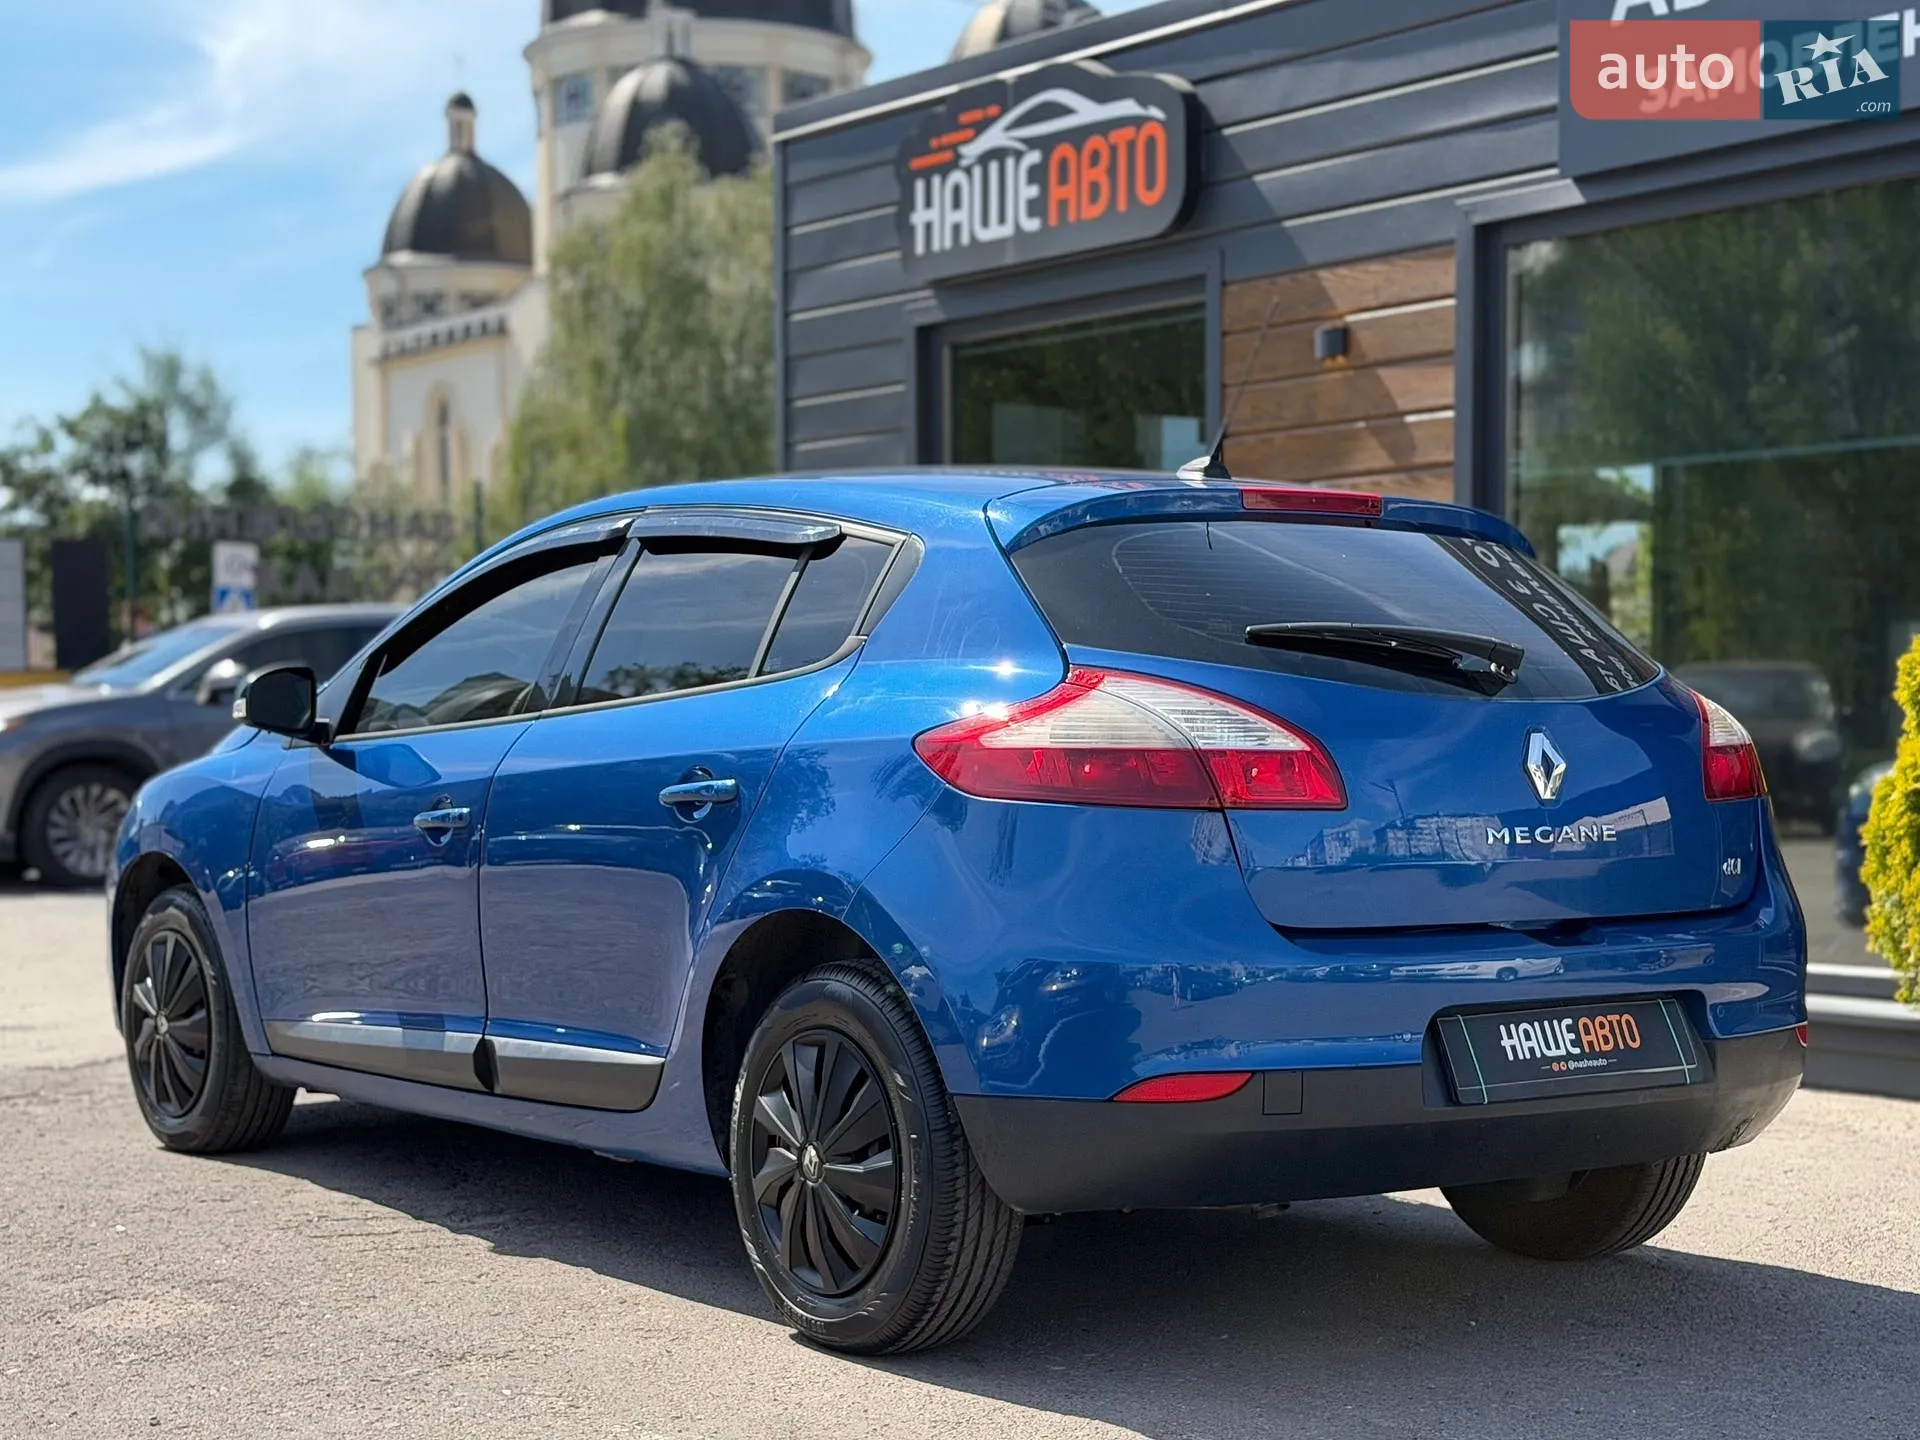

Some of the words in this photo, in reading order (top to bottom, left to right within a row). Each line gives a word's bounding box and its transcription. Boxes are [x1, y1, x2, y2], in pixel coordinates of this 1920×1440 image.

[909, 149, 1042, 256] НАШЕ
[1047, 120, 1167, 227] АВТО
[1485, 824, 1618, 845] MEGANE
[1499, 1018, 1580, 1061] НАШЕ
[1578, 1013, 1641, 1053] АВТО
